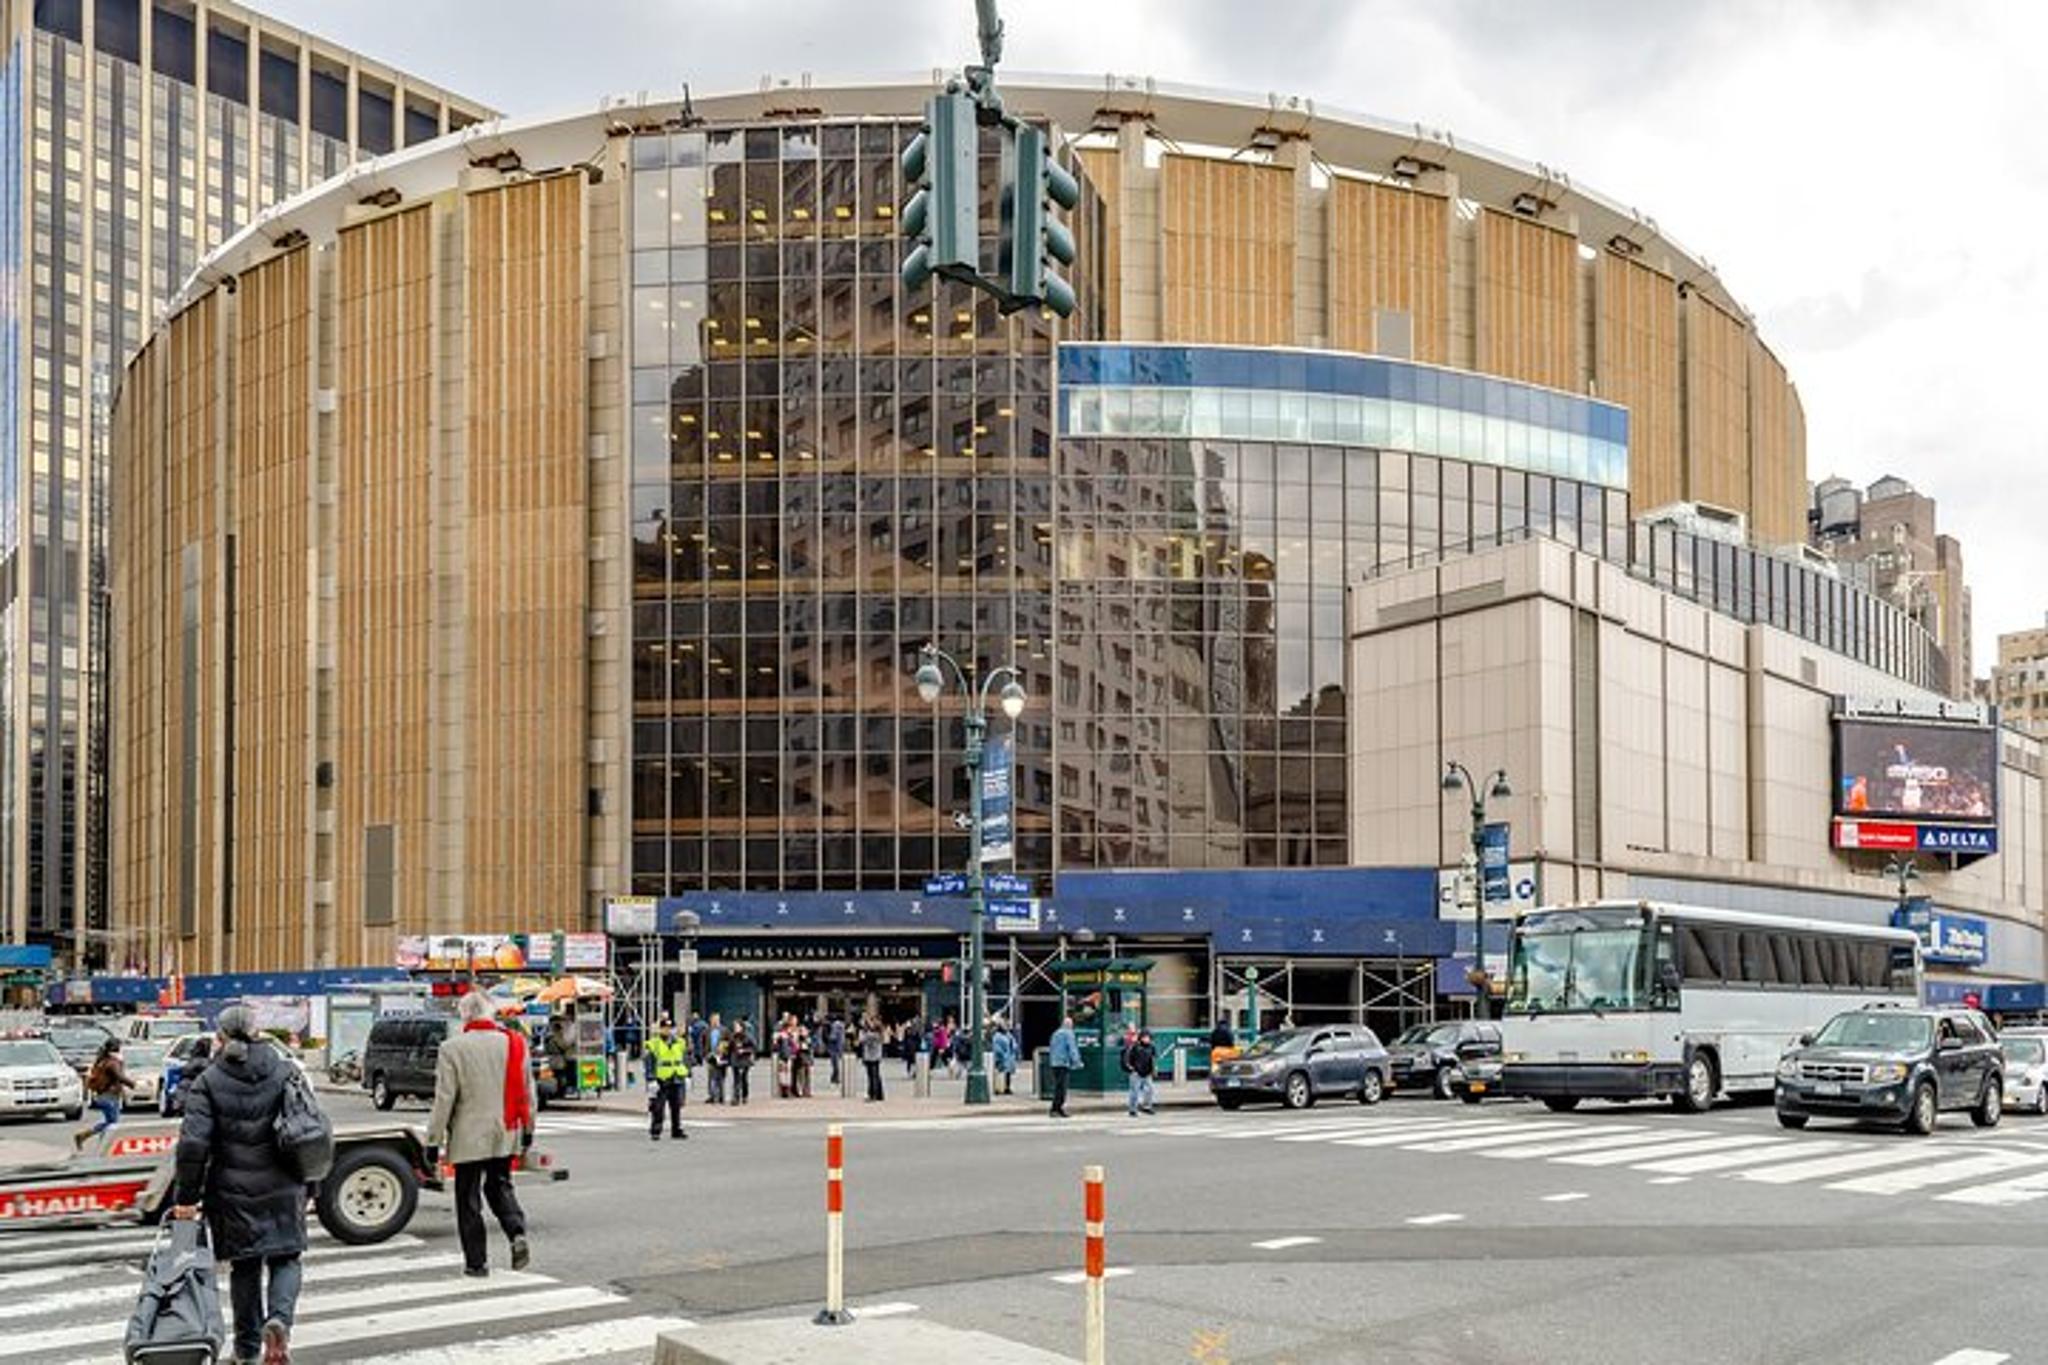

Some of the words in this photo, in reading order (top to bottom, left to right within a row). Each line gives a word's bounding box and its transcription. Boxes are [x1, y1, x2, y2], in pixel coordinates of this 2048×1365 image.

[1939, 831, 1989, 847] DELTA
[721, 946, 846, 959] PENNSYLVANIA
[853, 945, 920, 958] STATION
[122, 1137, 179, 1153] U-H
[0, 1194, 105, 1216] UHAUL
